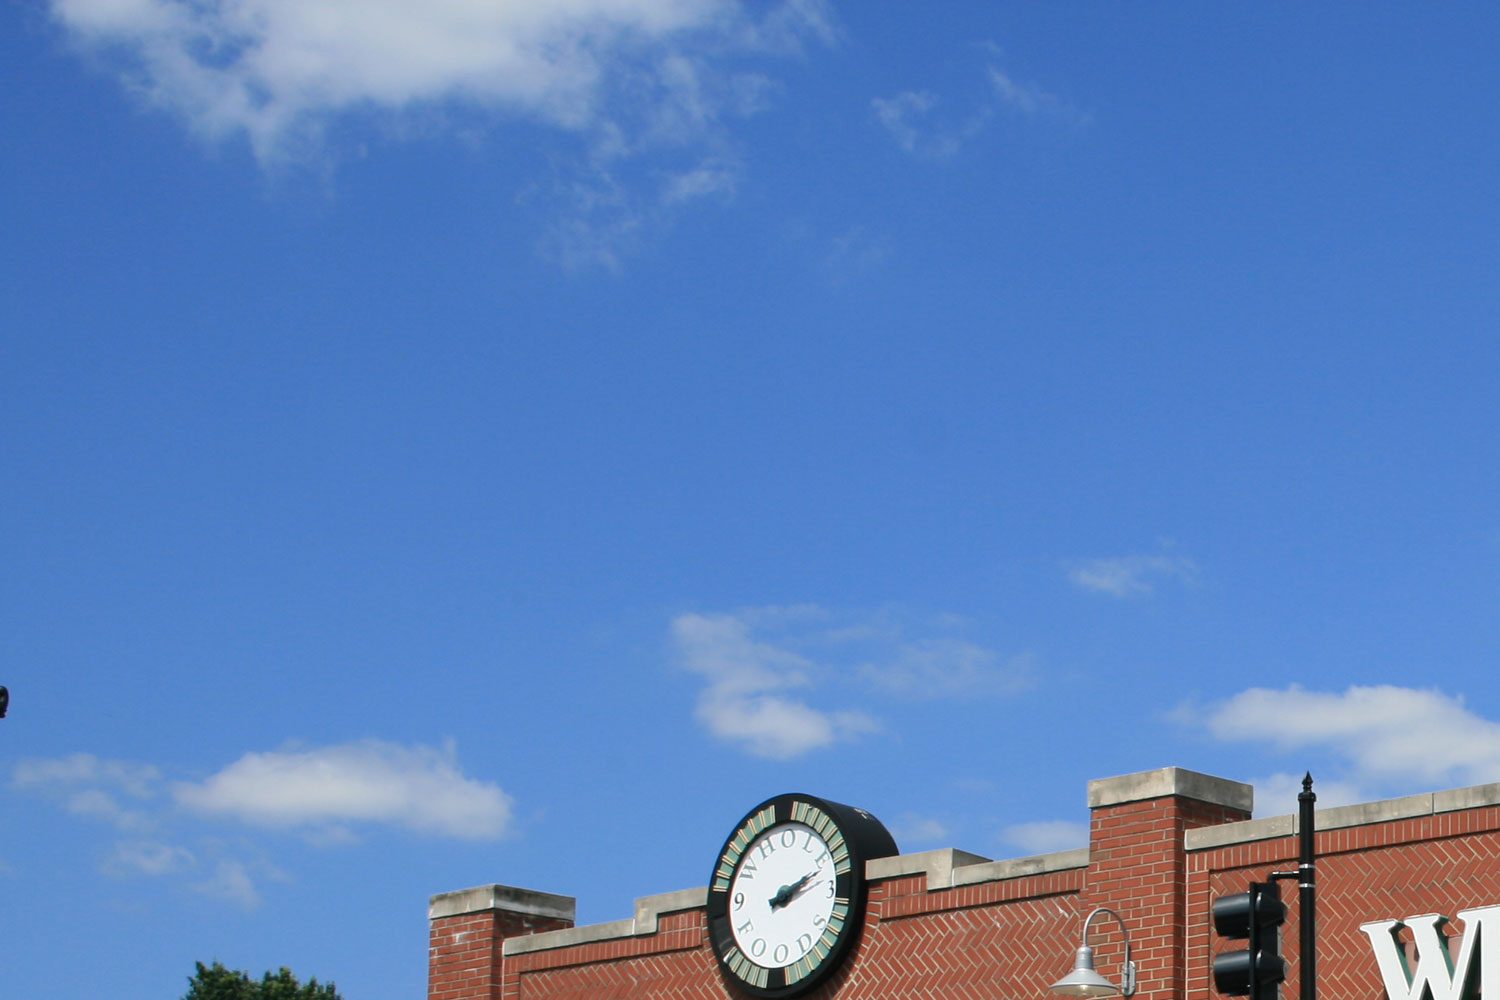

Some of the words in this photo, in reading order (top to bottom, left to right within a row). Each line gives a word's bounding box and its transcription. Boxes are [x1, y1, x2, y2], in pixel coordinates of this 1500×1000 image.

[739, 828, 831, 882] WHOLE
[733, 893, 745, 911] 9
[825, 880, 835, 899] 3
[738, 914, 826, 963] FOODS
